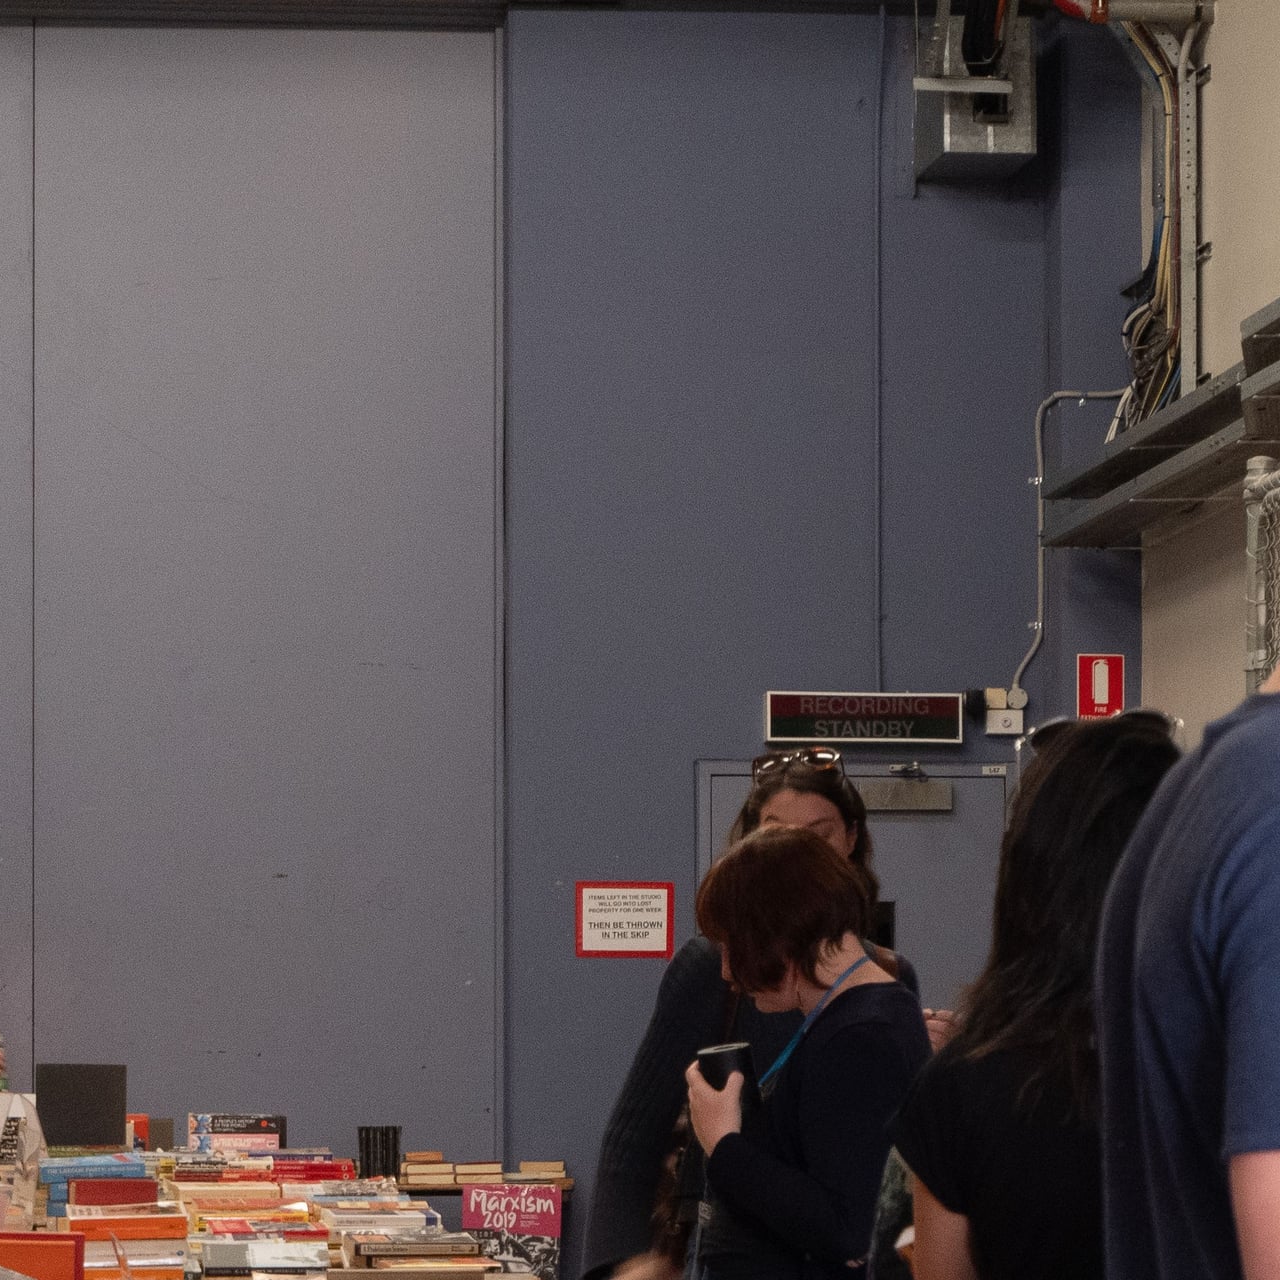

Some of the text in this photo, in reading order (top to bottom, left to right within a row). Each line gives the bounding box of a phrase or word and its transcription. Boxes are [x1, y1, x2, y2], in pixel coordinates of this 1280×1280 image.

[799, 696, 929, 715] RECORDING
[814, 720, 915, 738] STANDBY
[588, 921, 663, 929] THEN BE THROWN
[601, 931, 650, 939] IN THE SKIP
[470, 1188, 555, 1216] Marxism
[483, 1211, 517, 1228] 2019
